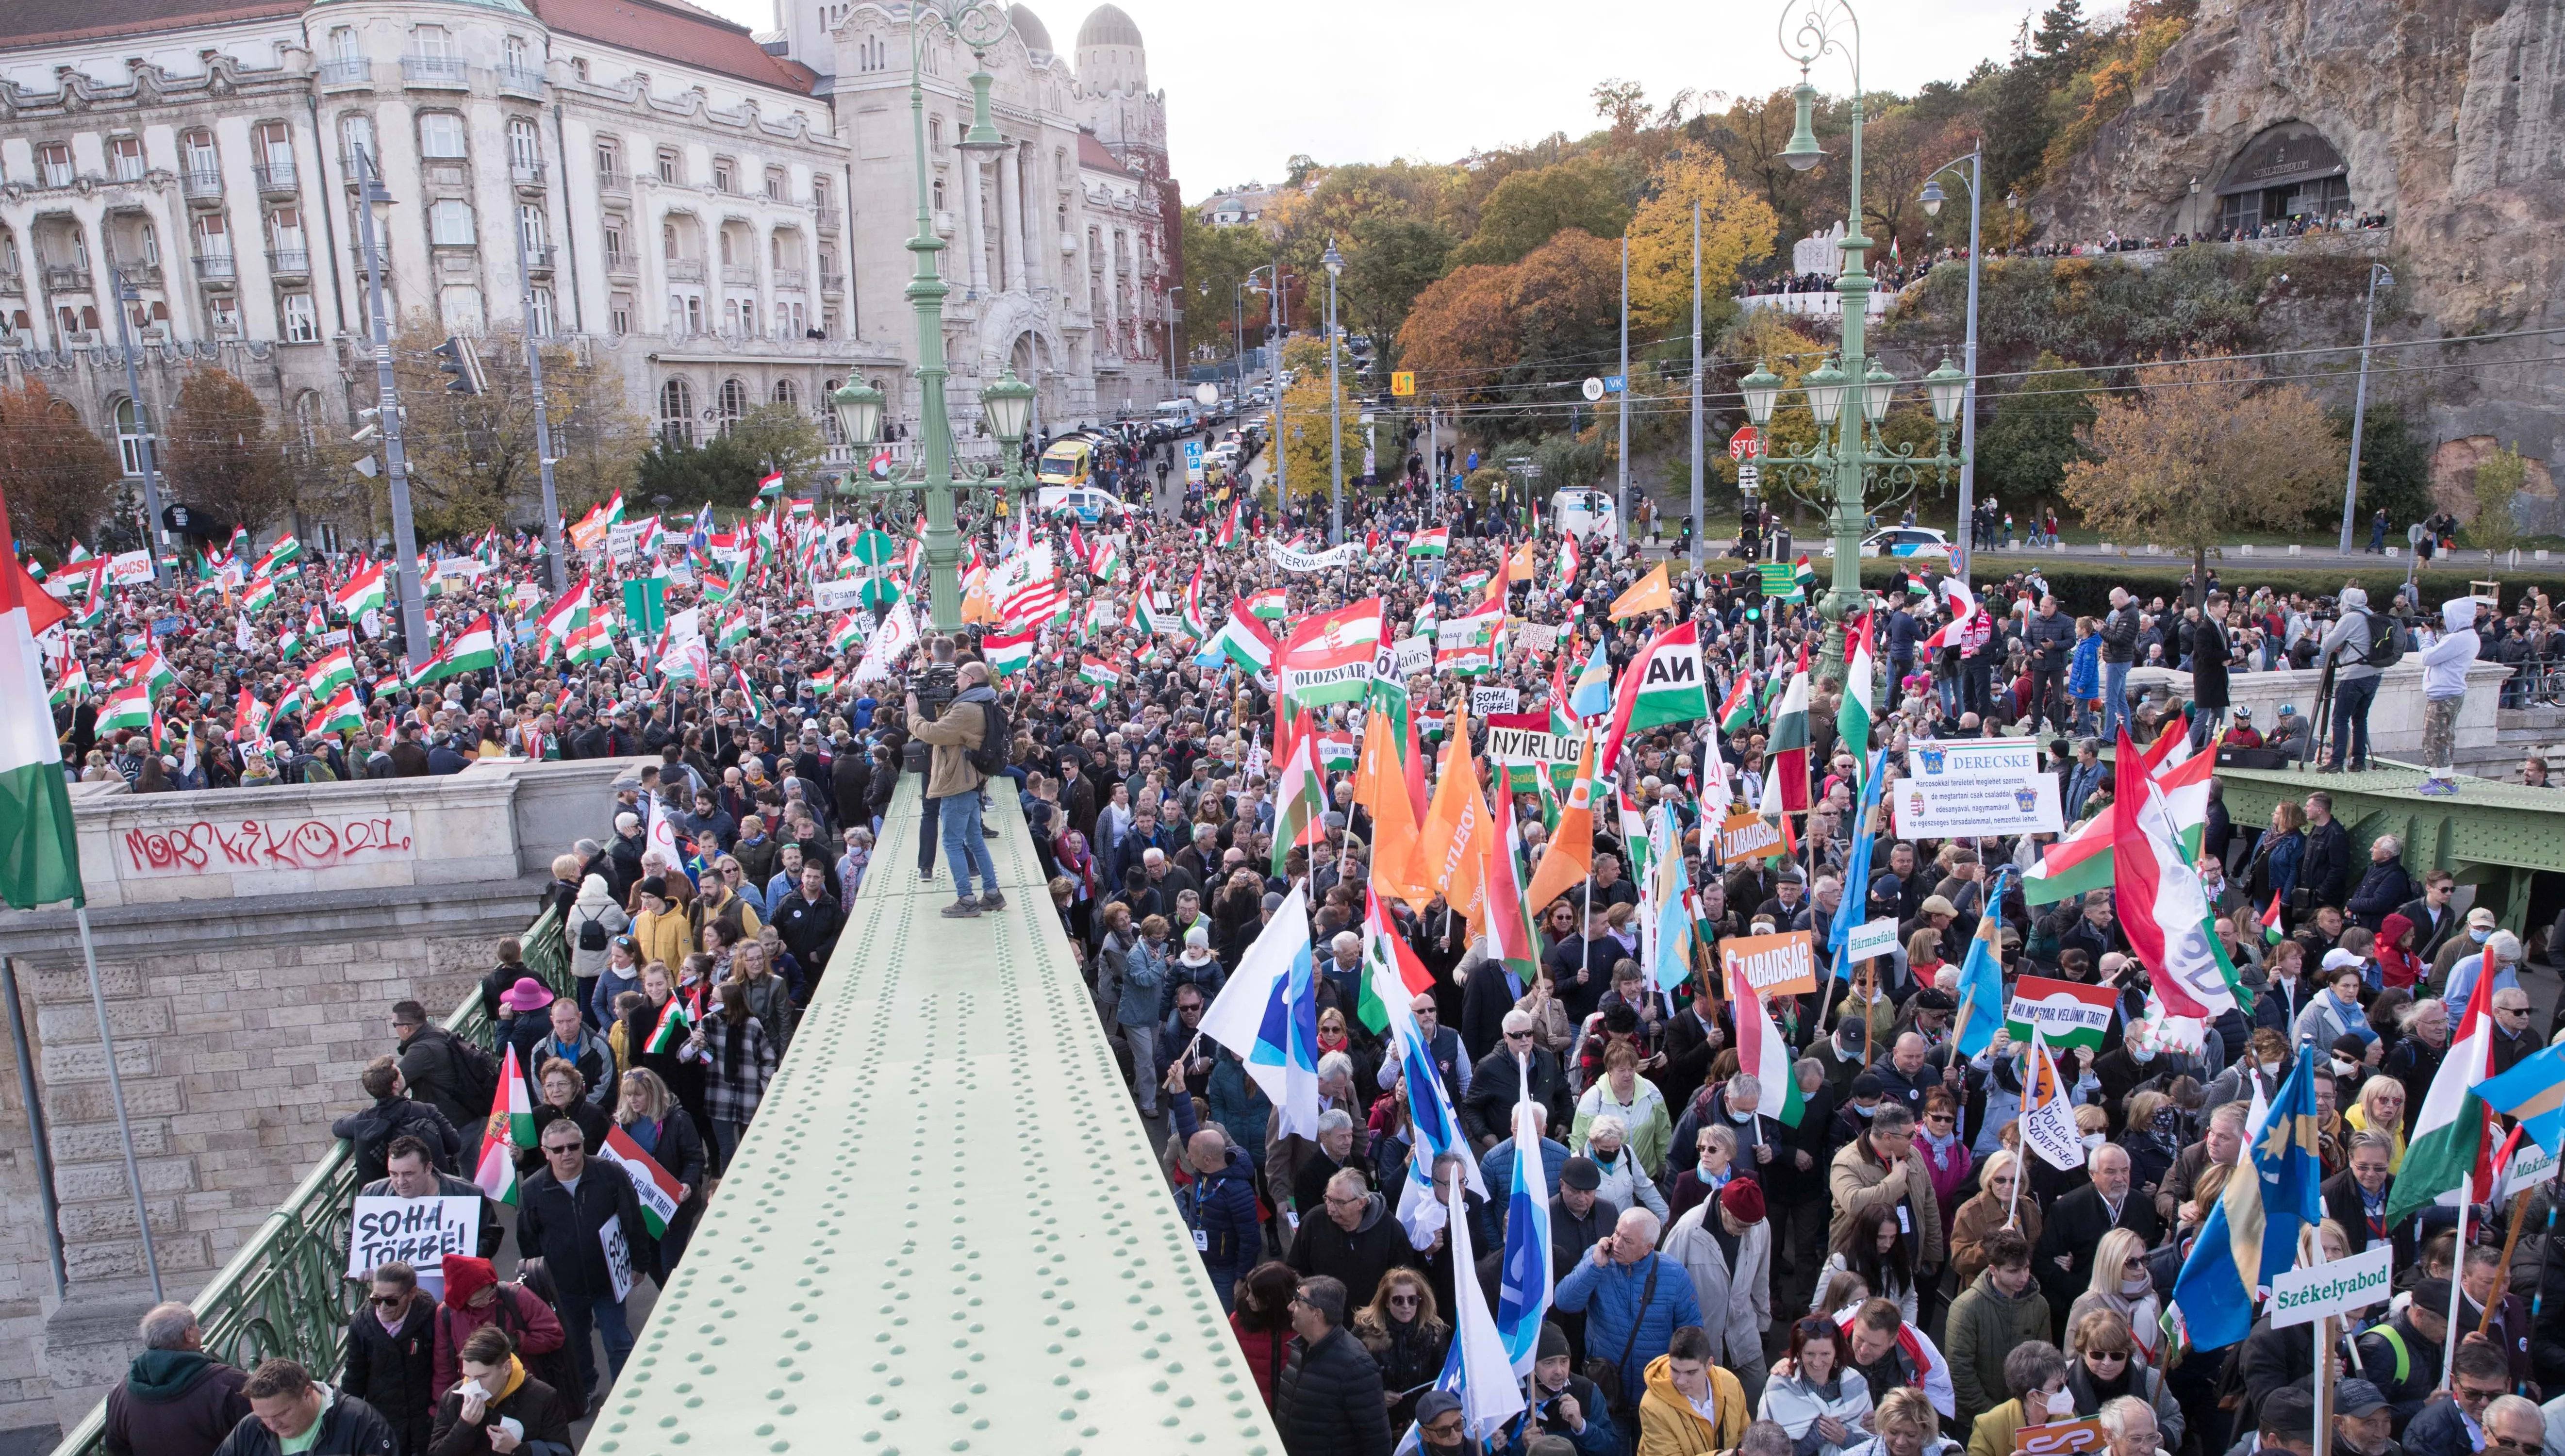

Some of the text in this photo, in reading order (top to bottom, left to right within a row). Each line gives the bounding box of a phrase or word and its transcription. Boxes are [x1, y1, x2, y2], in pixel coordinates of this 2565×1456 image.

[2253, 160, 2309, 179] SZIKLATEMPLOM
[1588, 384, 1598, 393] 10
[1609, 379, 1623, 388] VK
[1732, 439, 1765, 454] STO
[1191, 459, 1198, 467] P
[1522, 630, 1556, 644] VAGYUNK
[1521, 639, 1551, 650] VIKTOR
[1476, 690, 1509, 702] SOHA,
[1476, 699, 1513, 713] TÖBBÉ!
[1324, 746, 1339, 756] VELÜNK
[1340, 746, 1351, 756] TART!
[1953, 755, 2031, 769] DERECSKE
[1976, 778, 2002, 787] meglehet
[1939, 792, 1969, 801] megtartani
[1985, 790, 2013, 799] családdal,
[1936, 803, 2010, 814] édesanyával, nagymamával
[1918, 819, 1949, 827] egészséges
[1950, 816, 1993, 826] társadalommal,
[1994, 815, 2021, 824] nemzettel
[1851, 930, 1895, 951] Hármasfalu
[2012, 1002, 2025, 1016] AKI
[2057, 1007, 2086, 1023] VELÜNK
[2086, 1011, 2107, 1026] TART!
[2029, 1116, 2075, 1167] SZÖVETSÉG
[633, 1177, 657, 1203] VELÜNK
[654, 1195, 672, 1219] TART!
[359, 1199, 454, 1242] SOHA,
[359, 1222, 465, 1269] TÖBBÉ!
[2278, 1263, 2387, 1310] Székelyabod
